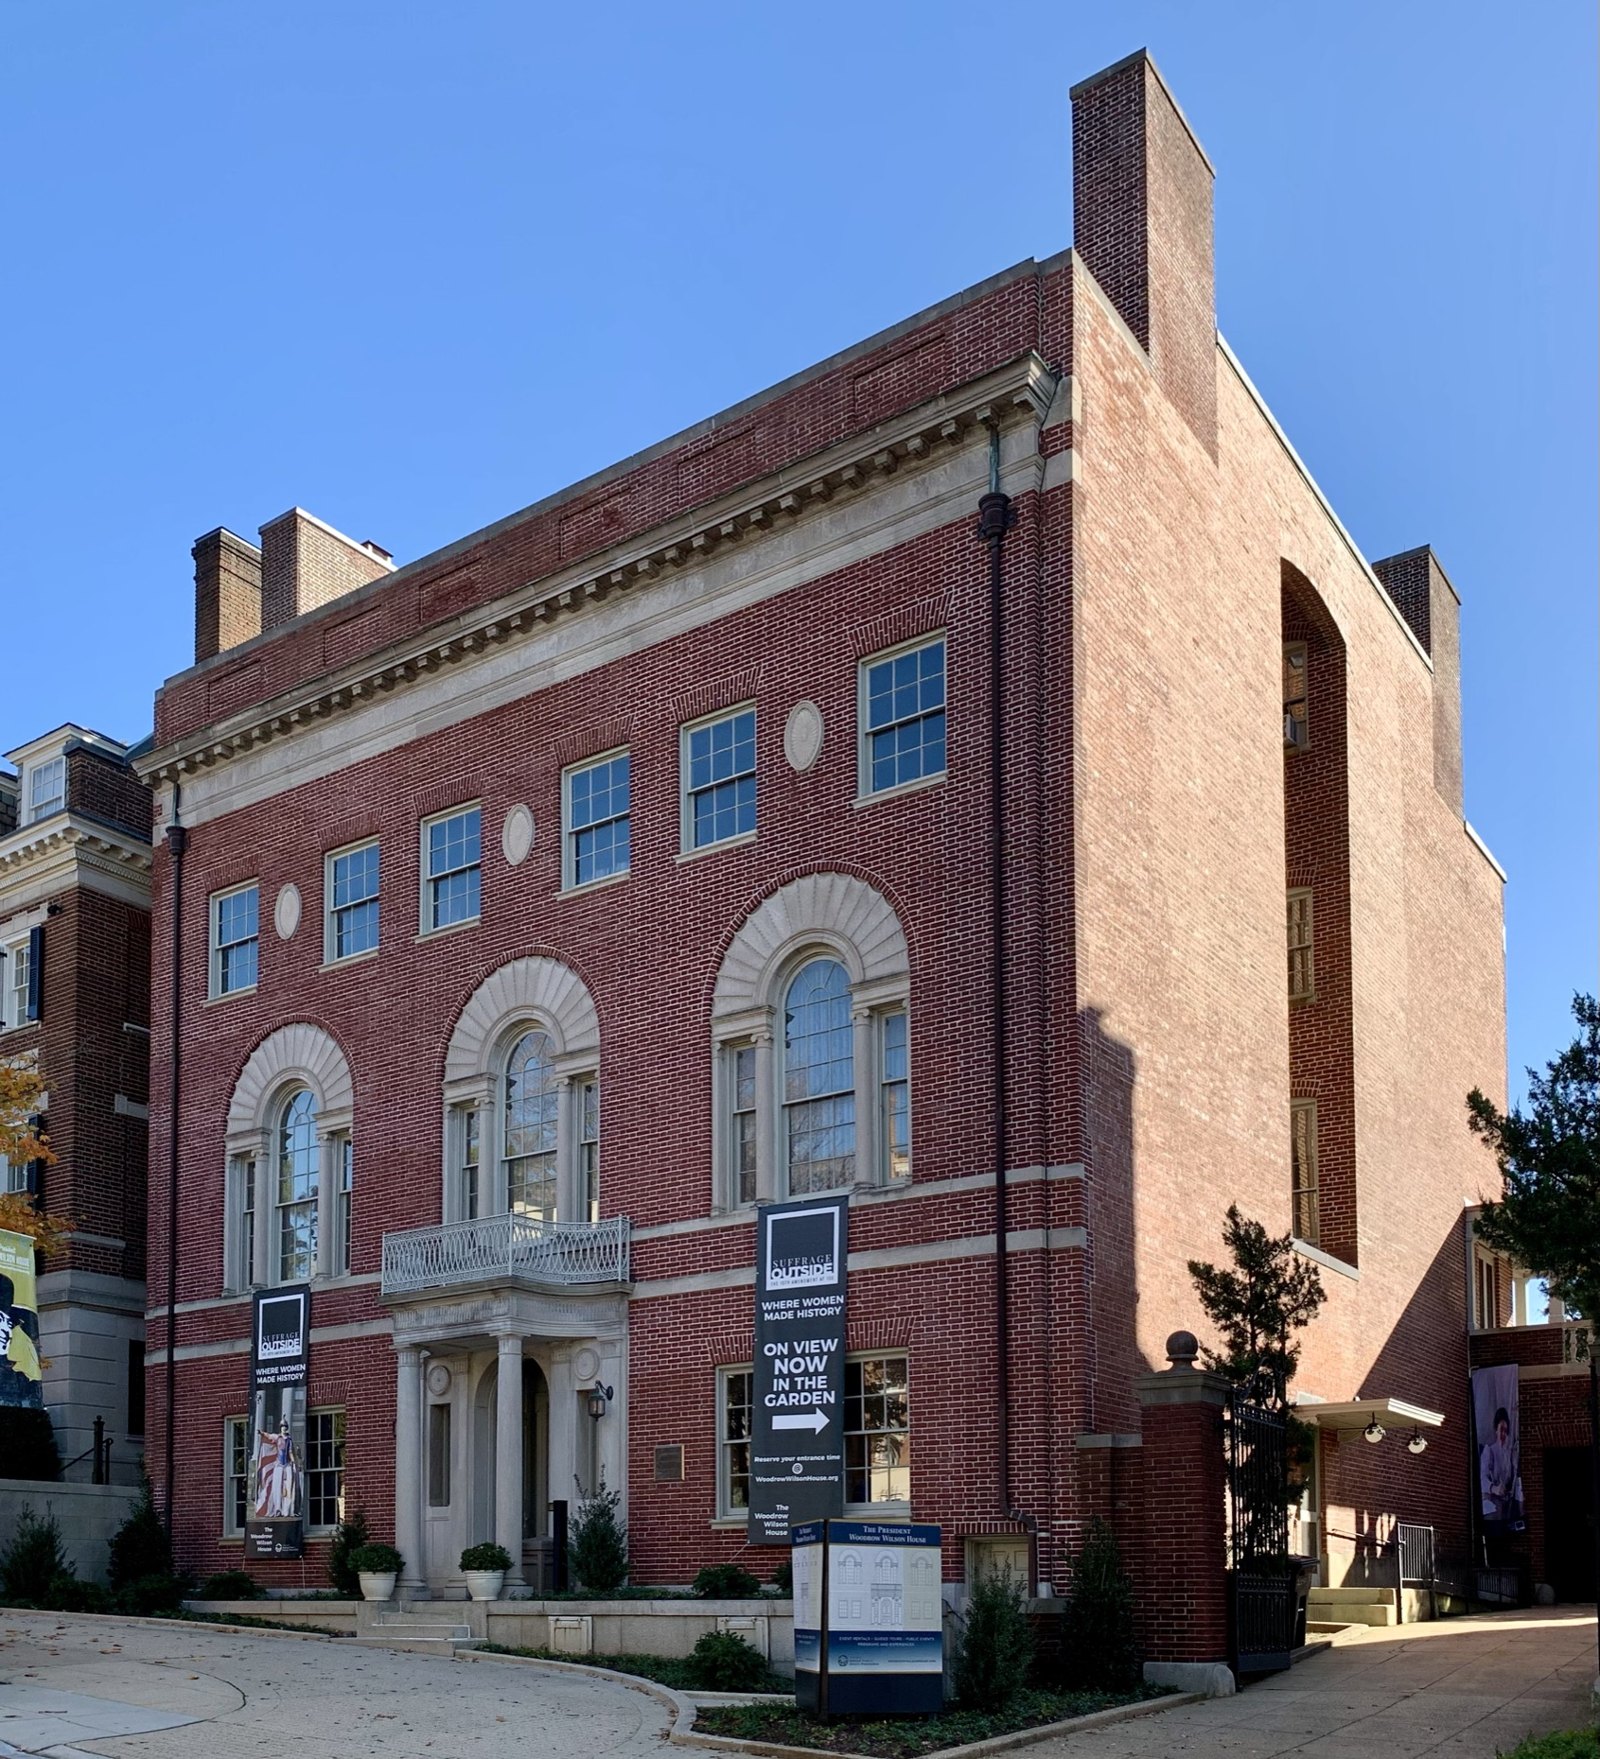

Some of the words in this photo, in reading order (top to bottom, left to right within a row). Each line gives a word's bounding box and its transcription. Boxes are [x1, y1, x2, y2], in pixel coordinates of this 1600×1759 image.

[772, 1254, 832, 1269] SUFFRAGE
[771, 1262, 833, 1279] OUTSIDE
[761, 1299, 800, 1311] WHERE
[802, 1295, 845, 1307] WOMEN
[764, 1310, 795, 1321] MADE
[796, 1306, 842, 1319] HISTORY
[262, 1338, 300, 1351] OUTSIDE
[263, 1332, 299, 1342] SUFFRAGE
[763, 1342, 789, 1356] ON
[793, 1338, 839, 1355] VIEW
[256, 1367, 279, 1376] WHERE
[280, 1364, 306, 1373] WOMEN
[774, 1355, 828, 1375] NOW
[257, 1376, 275, 1384] MADE
[277, 1373, 304, 1382] HISTORY
[773, 1377, 790, 1391] IN
[794, 1376, 828, 1390] THE
[764, 1390, 835, 1408] GARDEN
[755, 1475, 839, 1483] WoodrowWilsonHouse.org
[754, 1512, 790, 1520] Woodrow
[763, 1520, 789, 1528] Wilson
